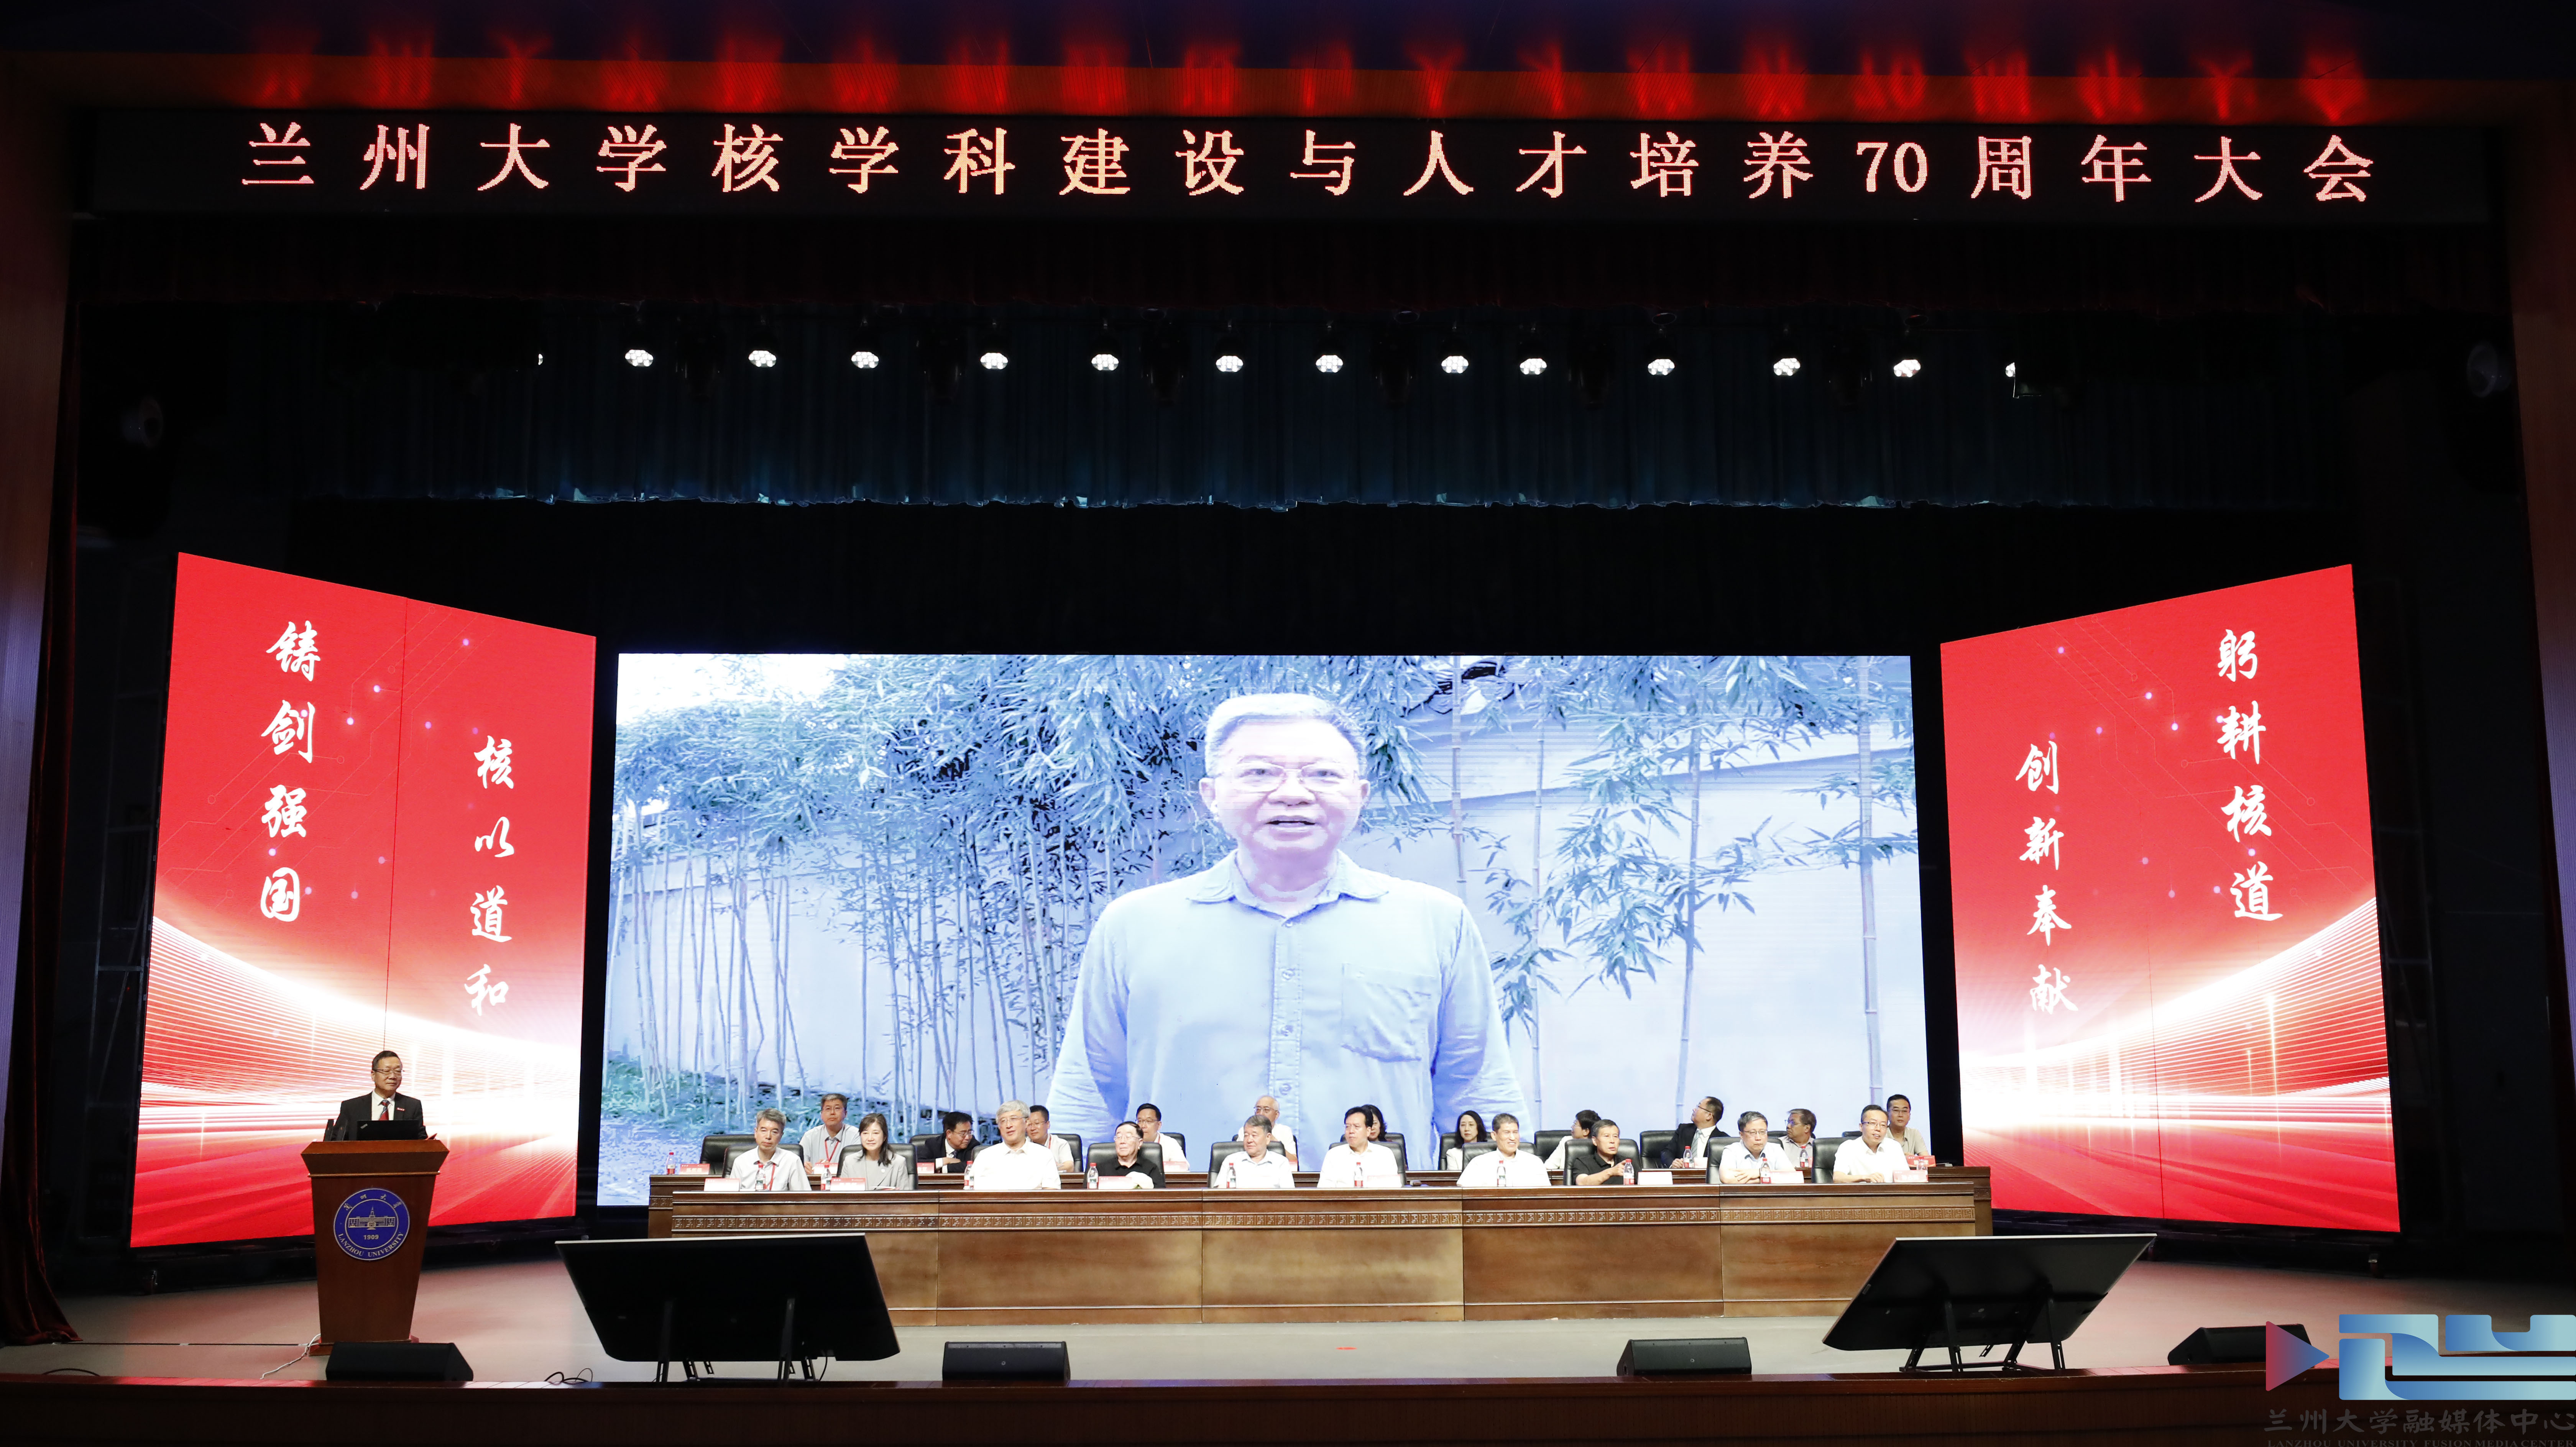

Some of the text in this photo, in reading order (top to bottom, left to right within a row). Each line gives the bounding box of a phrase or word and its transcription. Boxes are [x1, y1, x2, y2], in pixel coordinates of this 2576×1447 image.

[241, 122, 2374, 202] 兰州大学核学科建设与人才培养70周年大会
[260, 620, 320, 922] 铸剑强国
[464, 735, 515, 1016] 核以道和
[2015, 741, 2078, 1015] 创新奉献
[2217, 629, 2283, 921] 躬耕核道
[338, 1232, 404, 1257] LANZHOU UNIVERSITY
